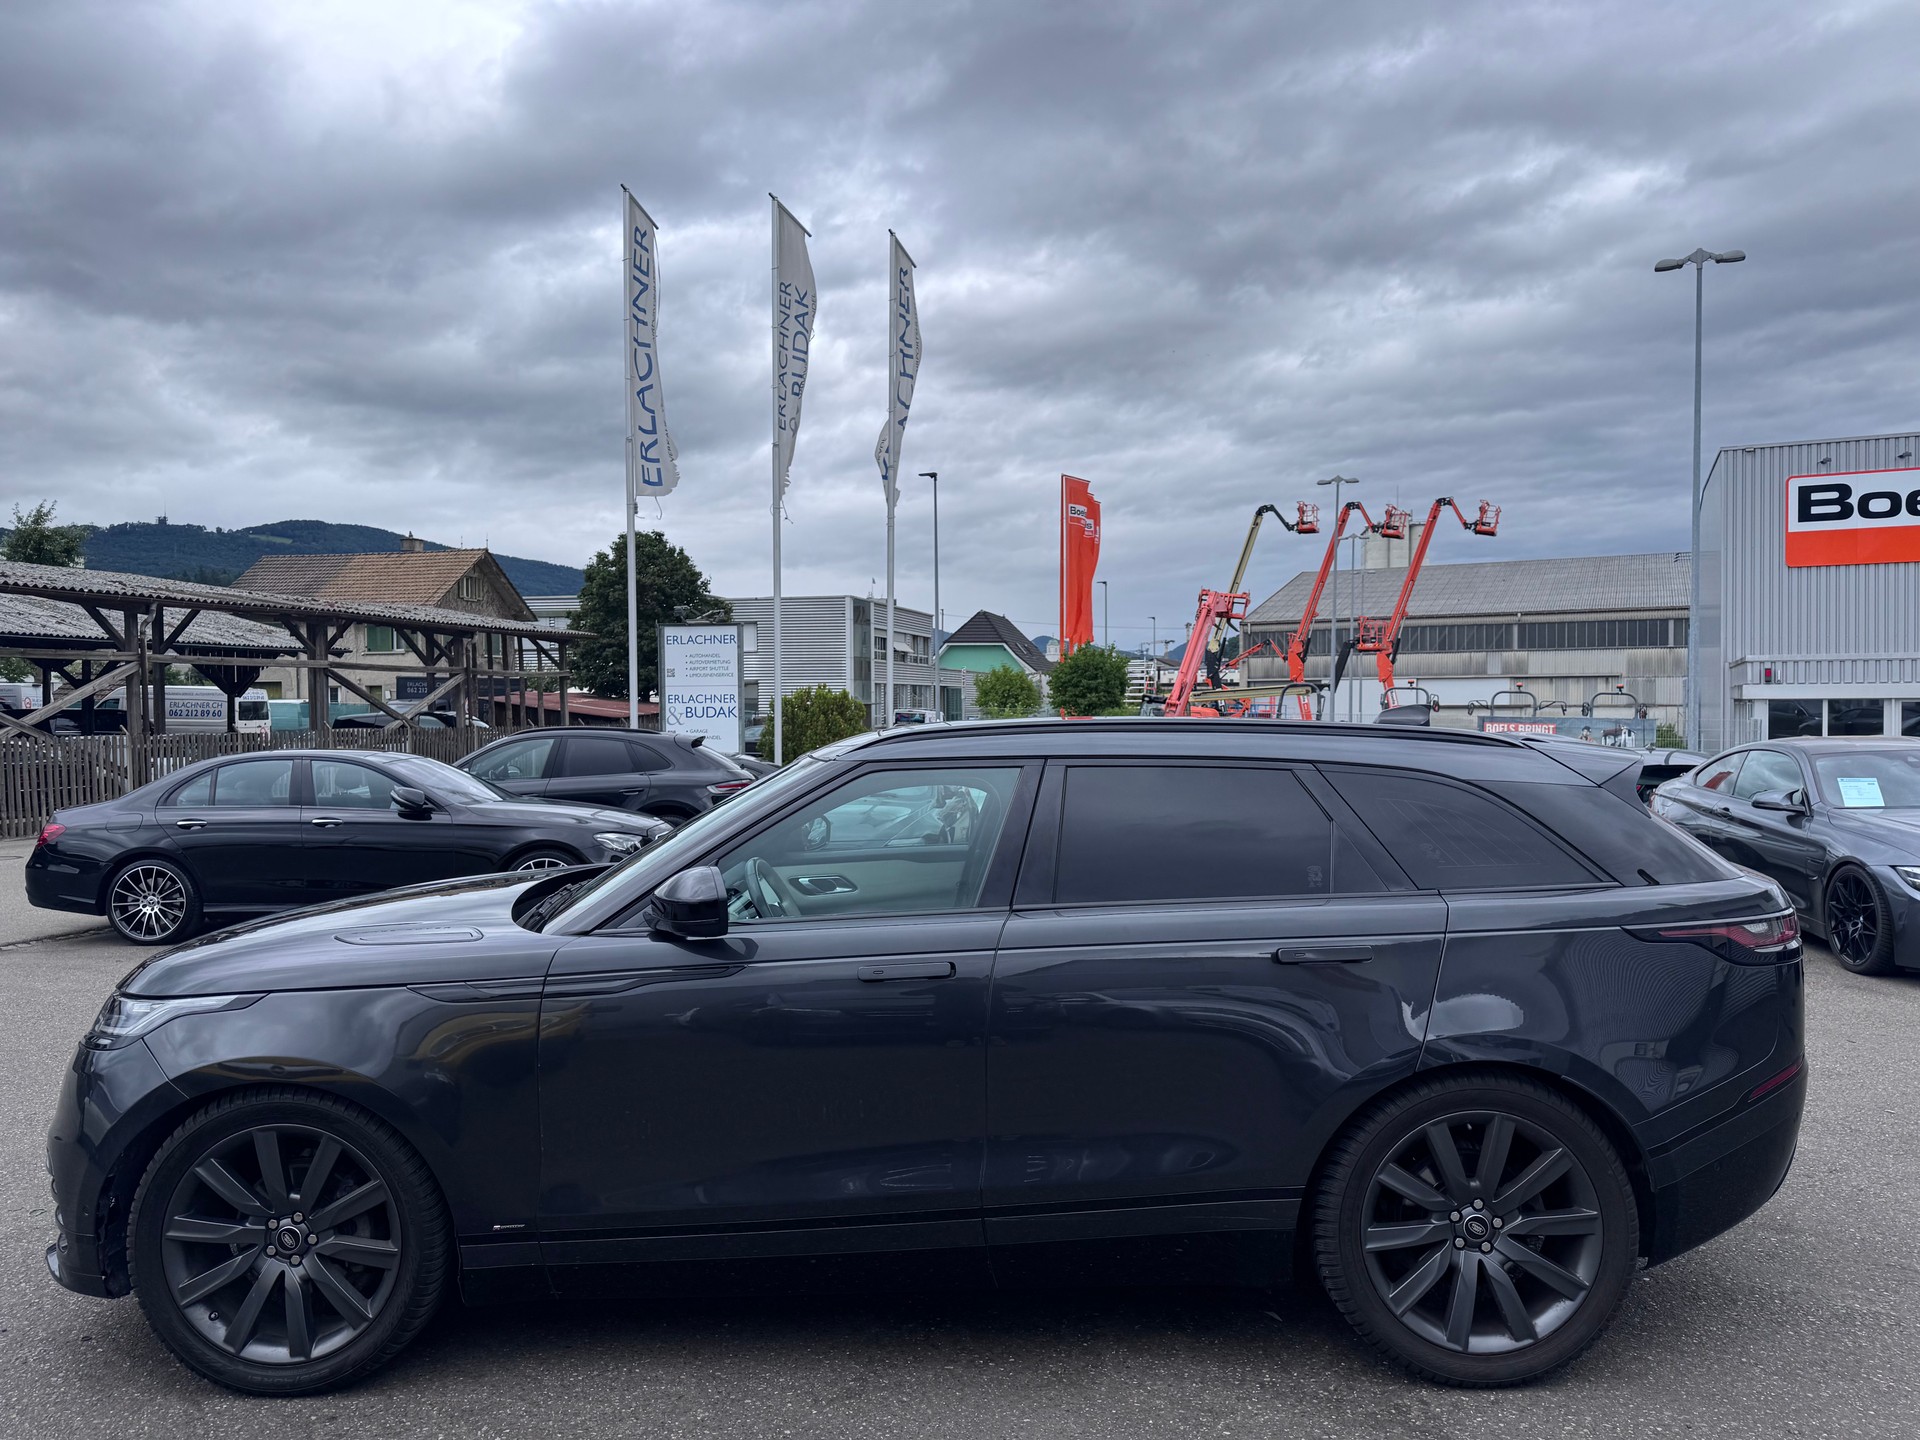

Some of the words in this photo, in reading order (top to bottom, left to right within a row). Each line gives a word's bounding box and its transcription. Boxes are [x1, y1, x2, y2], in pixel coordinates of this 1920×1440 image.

[633, 226, 663, 486] ERLACHNER
[778, 281, 792, 431] ERLACHNER
[666, 634, 737, 645] ERLACHNER
[667, 694, 737, 704] ERLACHNER
[169, 709, 183, 717] 062
[185, 709, 199, 717] 212
[212, 710, 222, 718] 60
[667, 706, 685, 726] &
[685, 706, 738, 718] BUDAK
[1518, 724, 1556, 734] BRINGT
